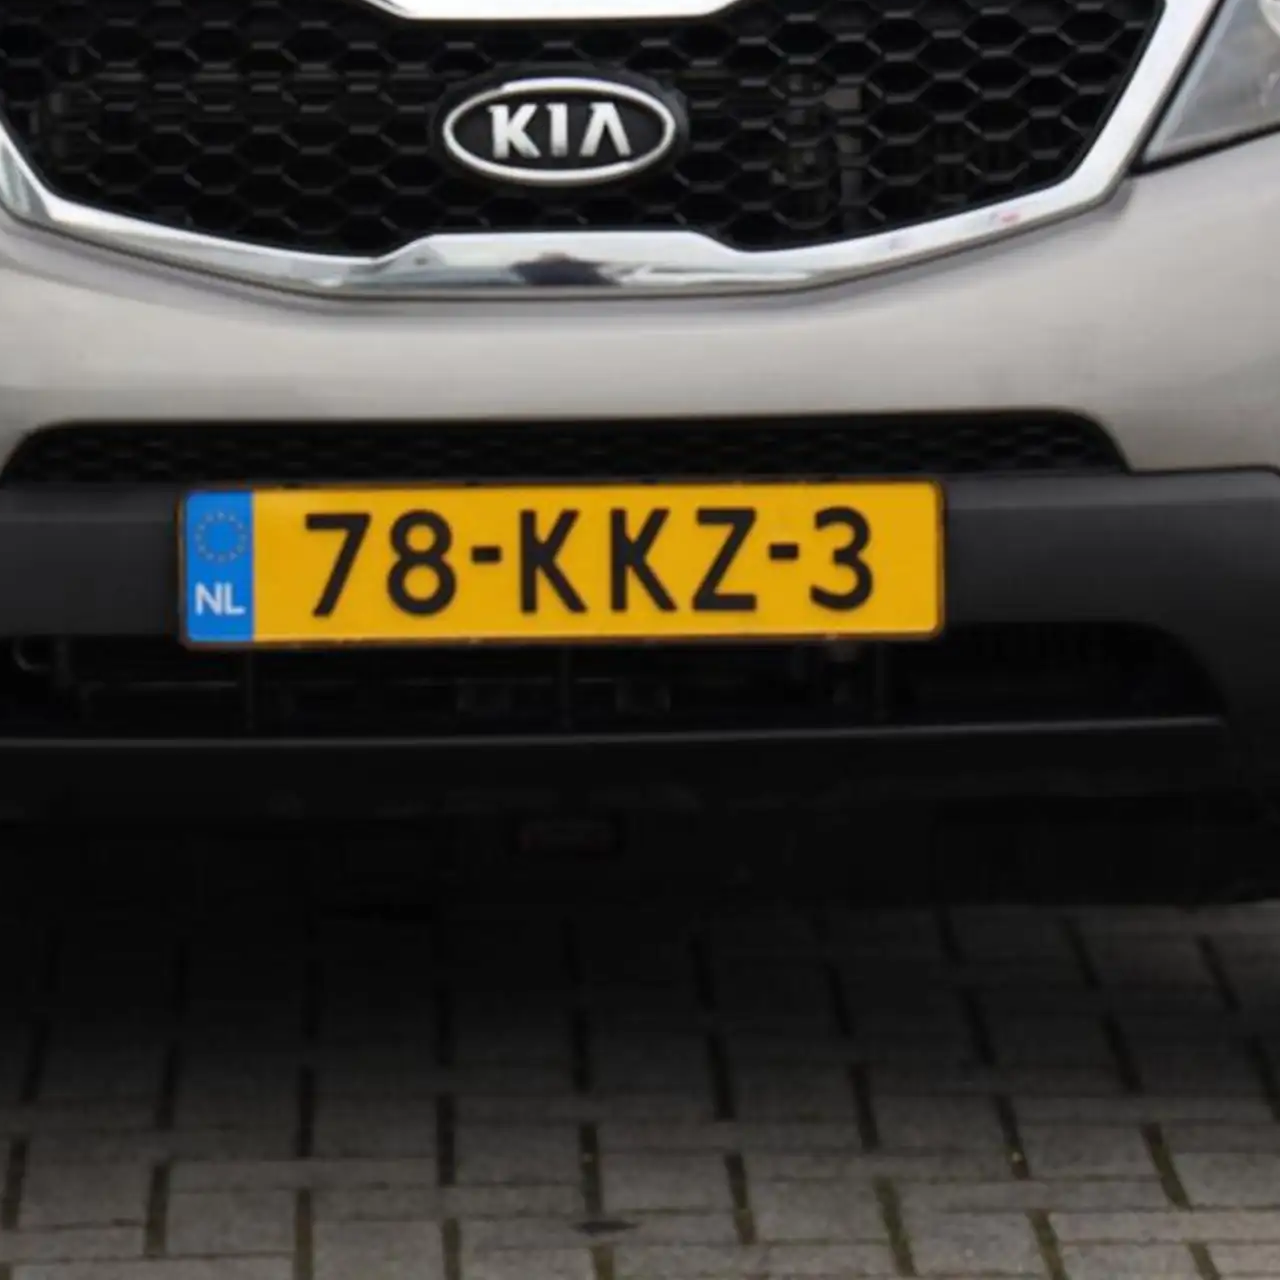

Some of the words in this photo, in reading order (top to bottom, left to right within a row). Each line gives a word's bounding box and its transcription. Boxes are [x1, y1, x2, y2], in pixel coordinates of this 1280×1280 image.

[487, 102, 632, 160] KIA
[305, 506, 874, 617] 78-KKZ-3
[194, 582, 246, 616] NL
